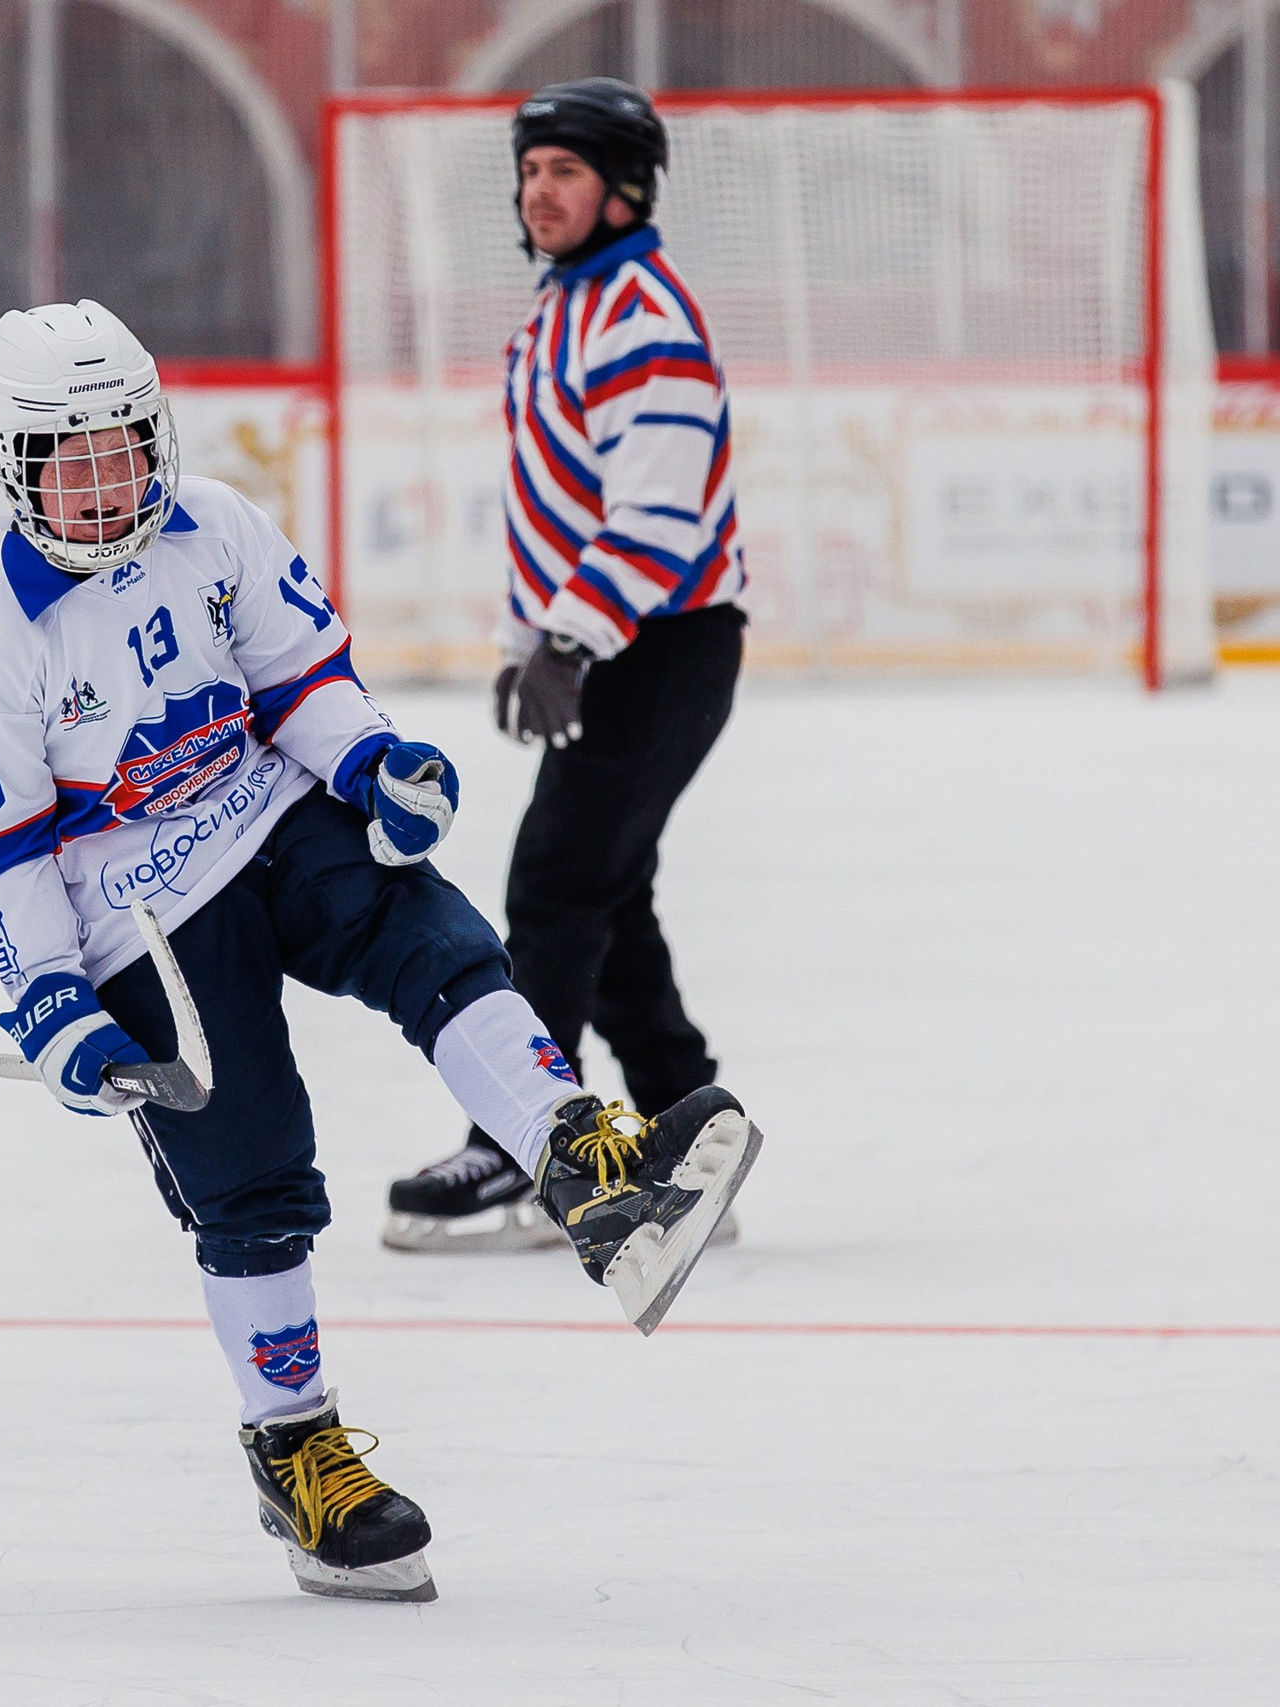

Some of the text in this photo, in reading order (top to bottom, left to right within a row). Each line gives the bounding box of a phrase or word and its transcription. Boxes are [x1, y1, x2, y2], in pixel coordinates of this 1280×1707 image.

[68, 378, 125, 395] WARRIOR
[87, 543, 130, 559] JOFA
[113, 571, 146, 595] We Match
[126, 605, 180, 688] 13
[127, 717, 244, 785] СИБСЕЛЬМАШ
[145, 747, 240, 815] НОВОСИБИРСКАЯ
[8, 985, 79, 1045] AUER
